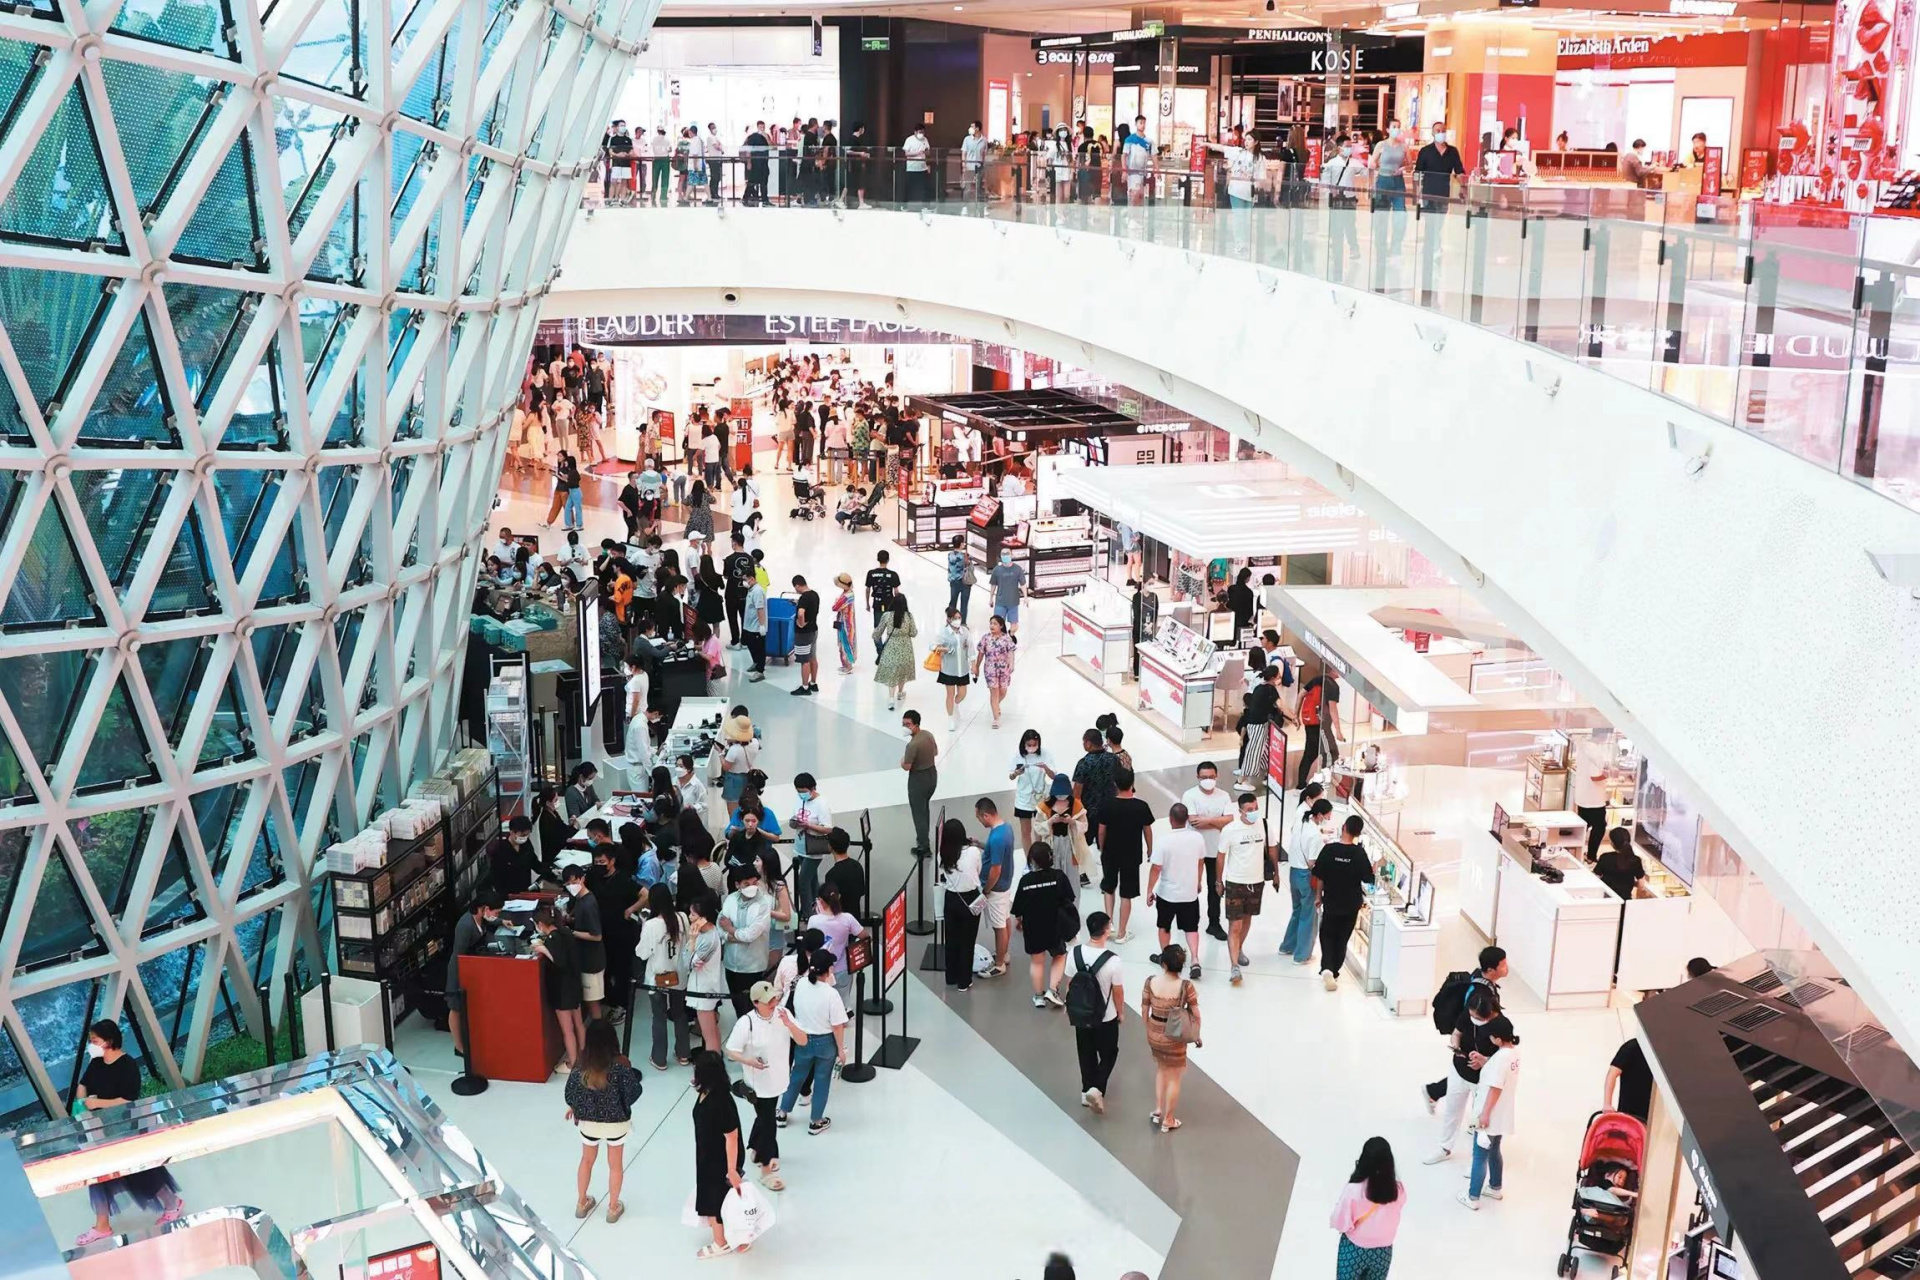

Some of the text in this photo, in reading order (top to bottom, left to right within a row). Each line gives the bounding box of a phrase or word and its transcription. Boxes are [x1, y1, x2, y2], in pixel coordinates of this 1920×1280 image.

[1248, 29, 1332, 42] PENHALIGON'S
[1557, 37, 1650, 56] Elizabeth Arden
[594, 314, 695, 336] LAUDER
